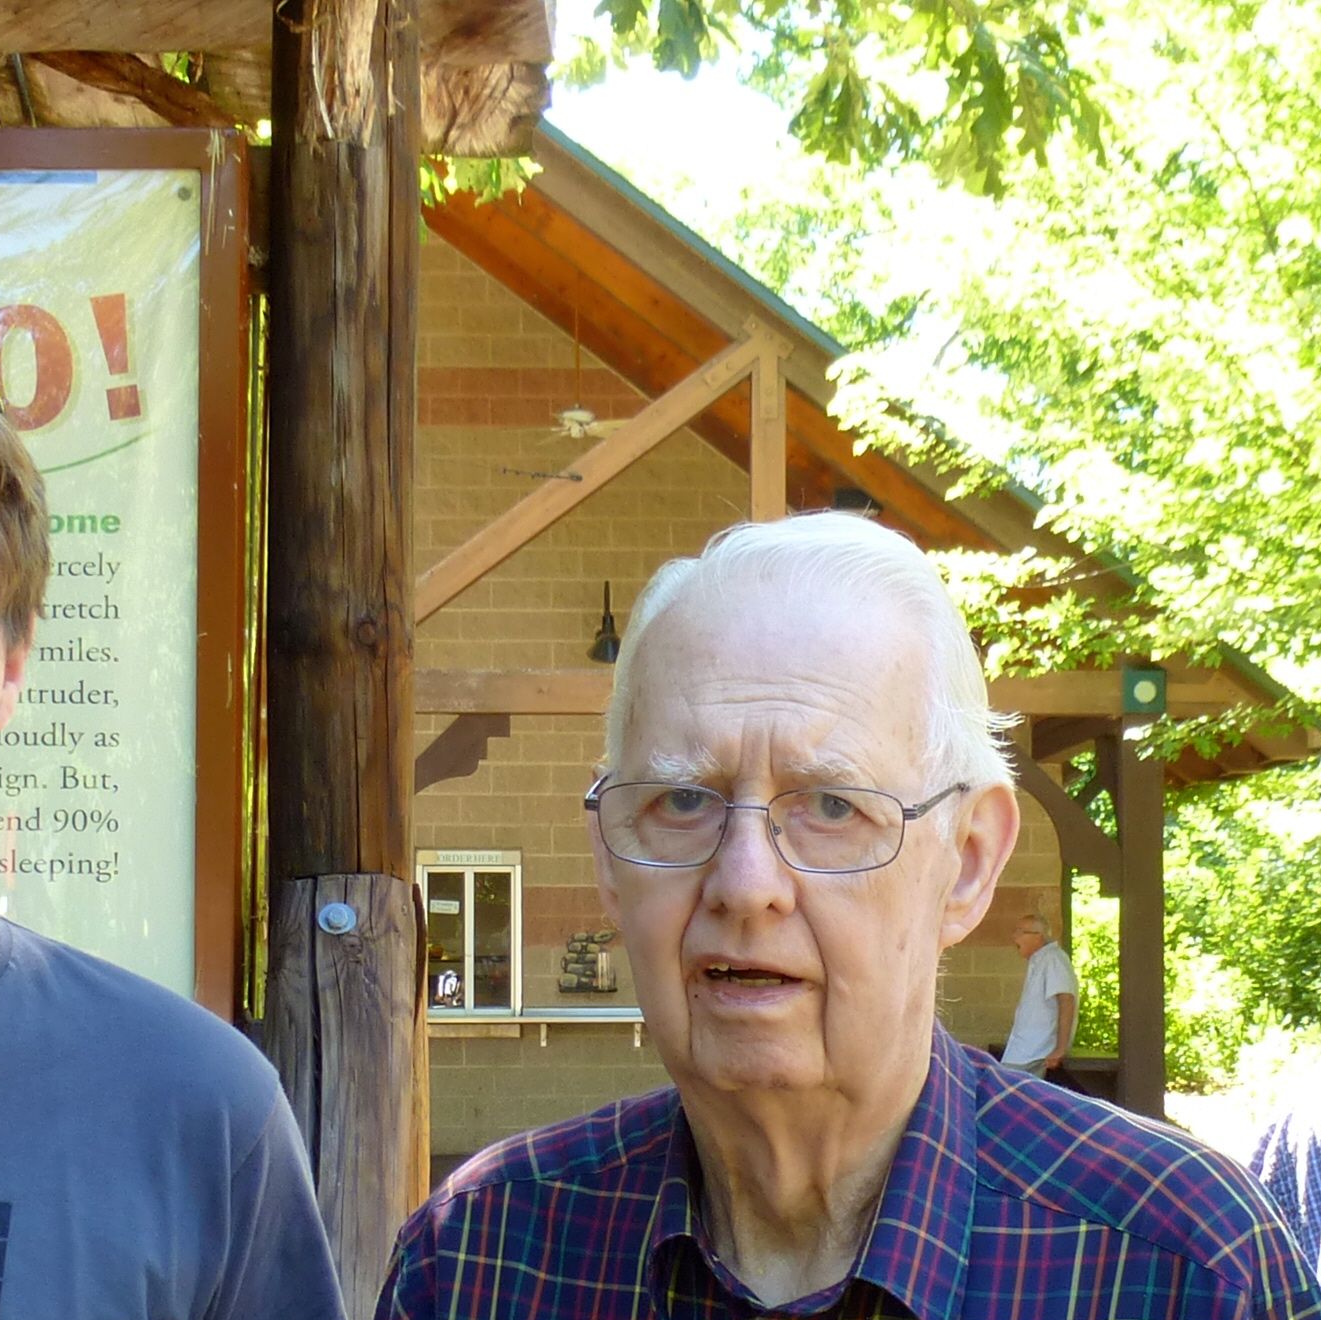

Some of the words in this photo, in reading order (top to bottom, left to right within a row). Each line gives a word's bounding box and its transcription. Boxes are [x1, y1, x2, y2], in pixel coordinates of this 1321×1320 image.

[48, 512, 121, 534] ome
[52, 552, 121, 584] rcely
[39, 637, 120, 662] miles.
[93, 731, 120, 748] as
[60, 765, 119, 794] But,
[53, 808, 119, 834] 90%
